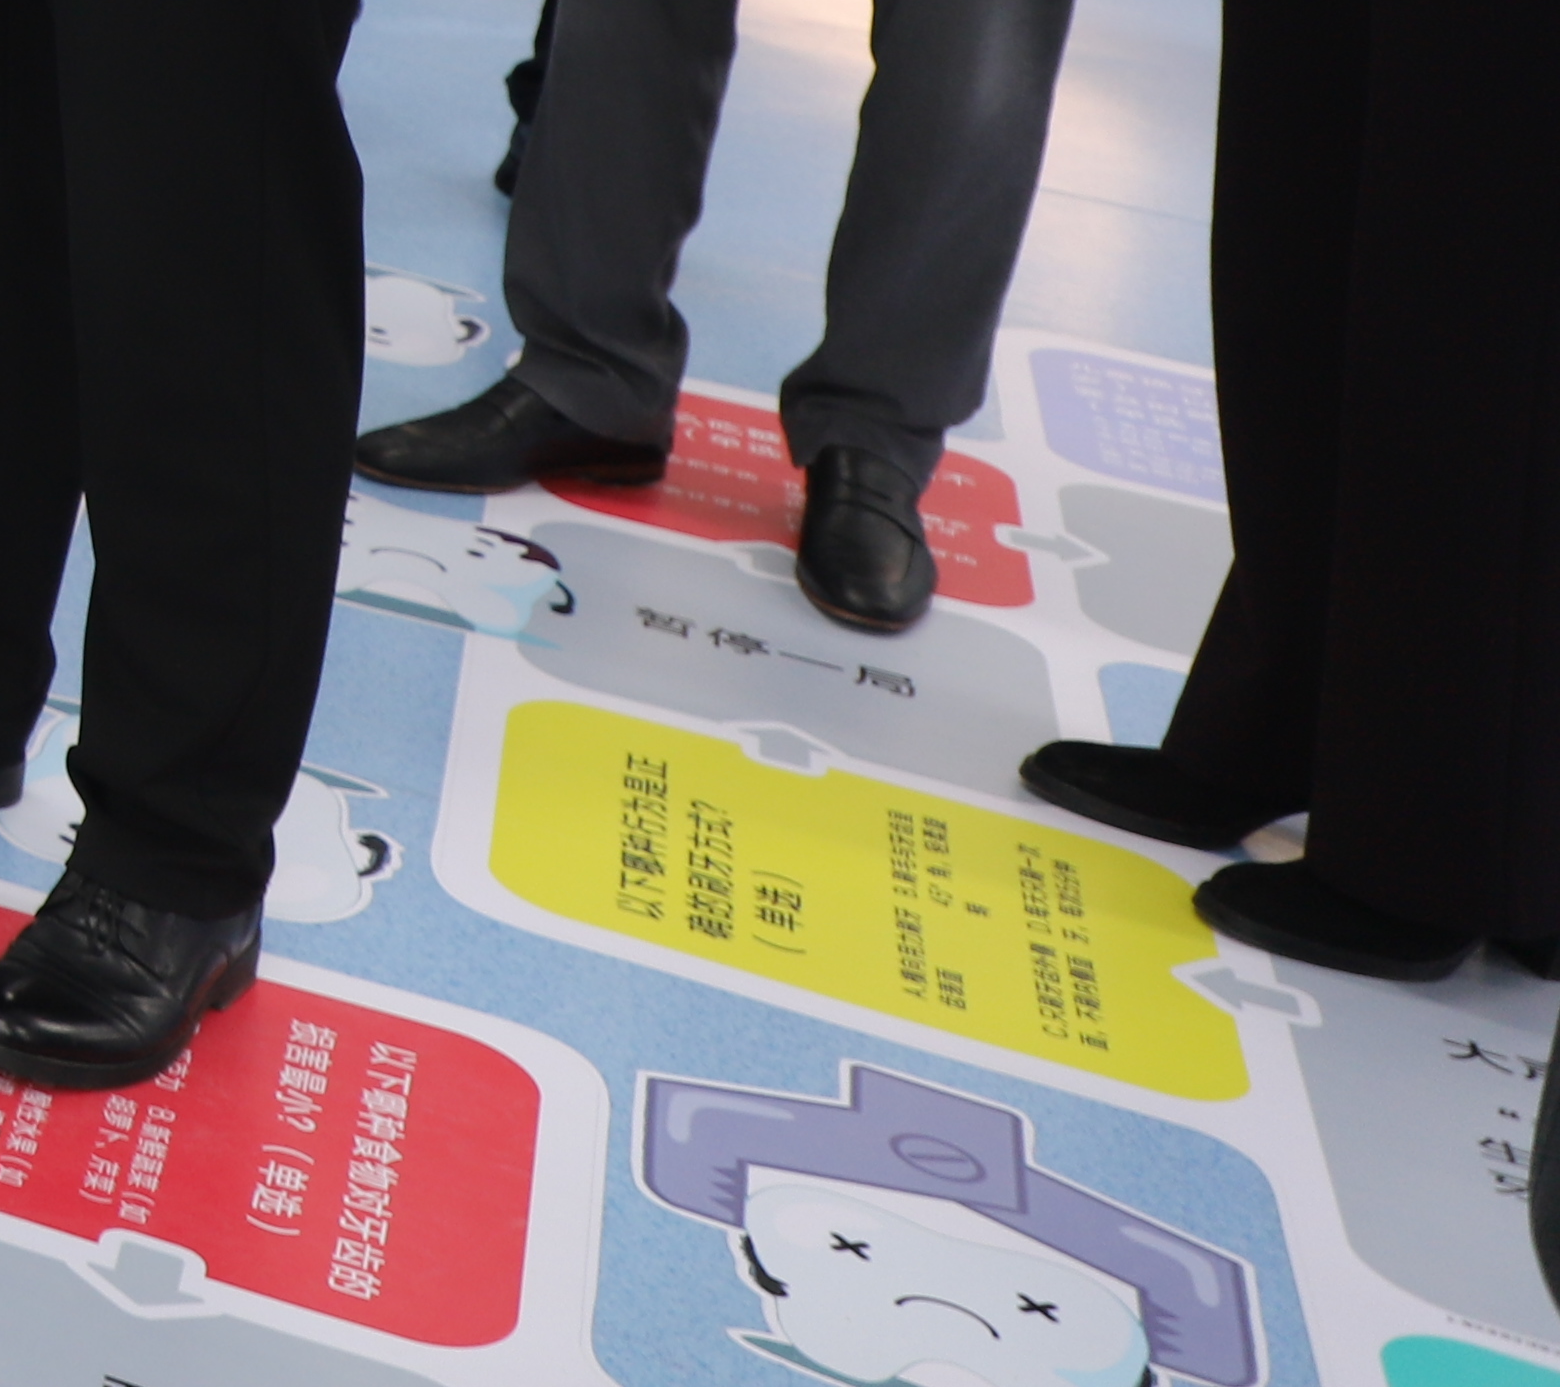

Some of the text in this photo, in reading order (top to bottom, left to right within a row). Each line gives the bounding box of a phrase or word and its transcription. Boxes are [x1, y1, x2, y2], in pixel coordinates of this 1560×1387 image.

[635, 603, 918, 698] 暂停一局
[328, 1040, 418, 1302] 以下哪种食物对牙齿的
